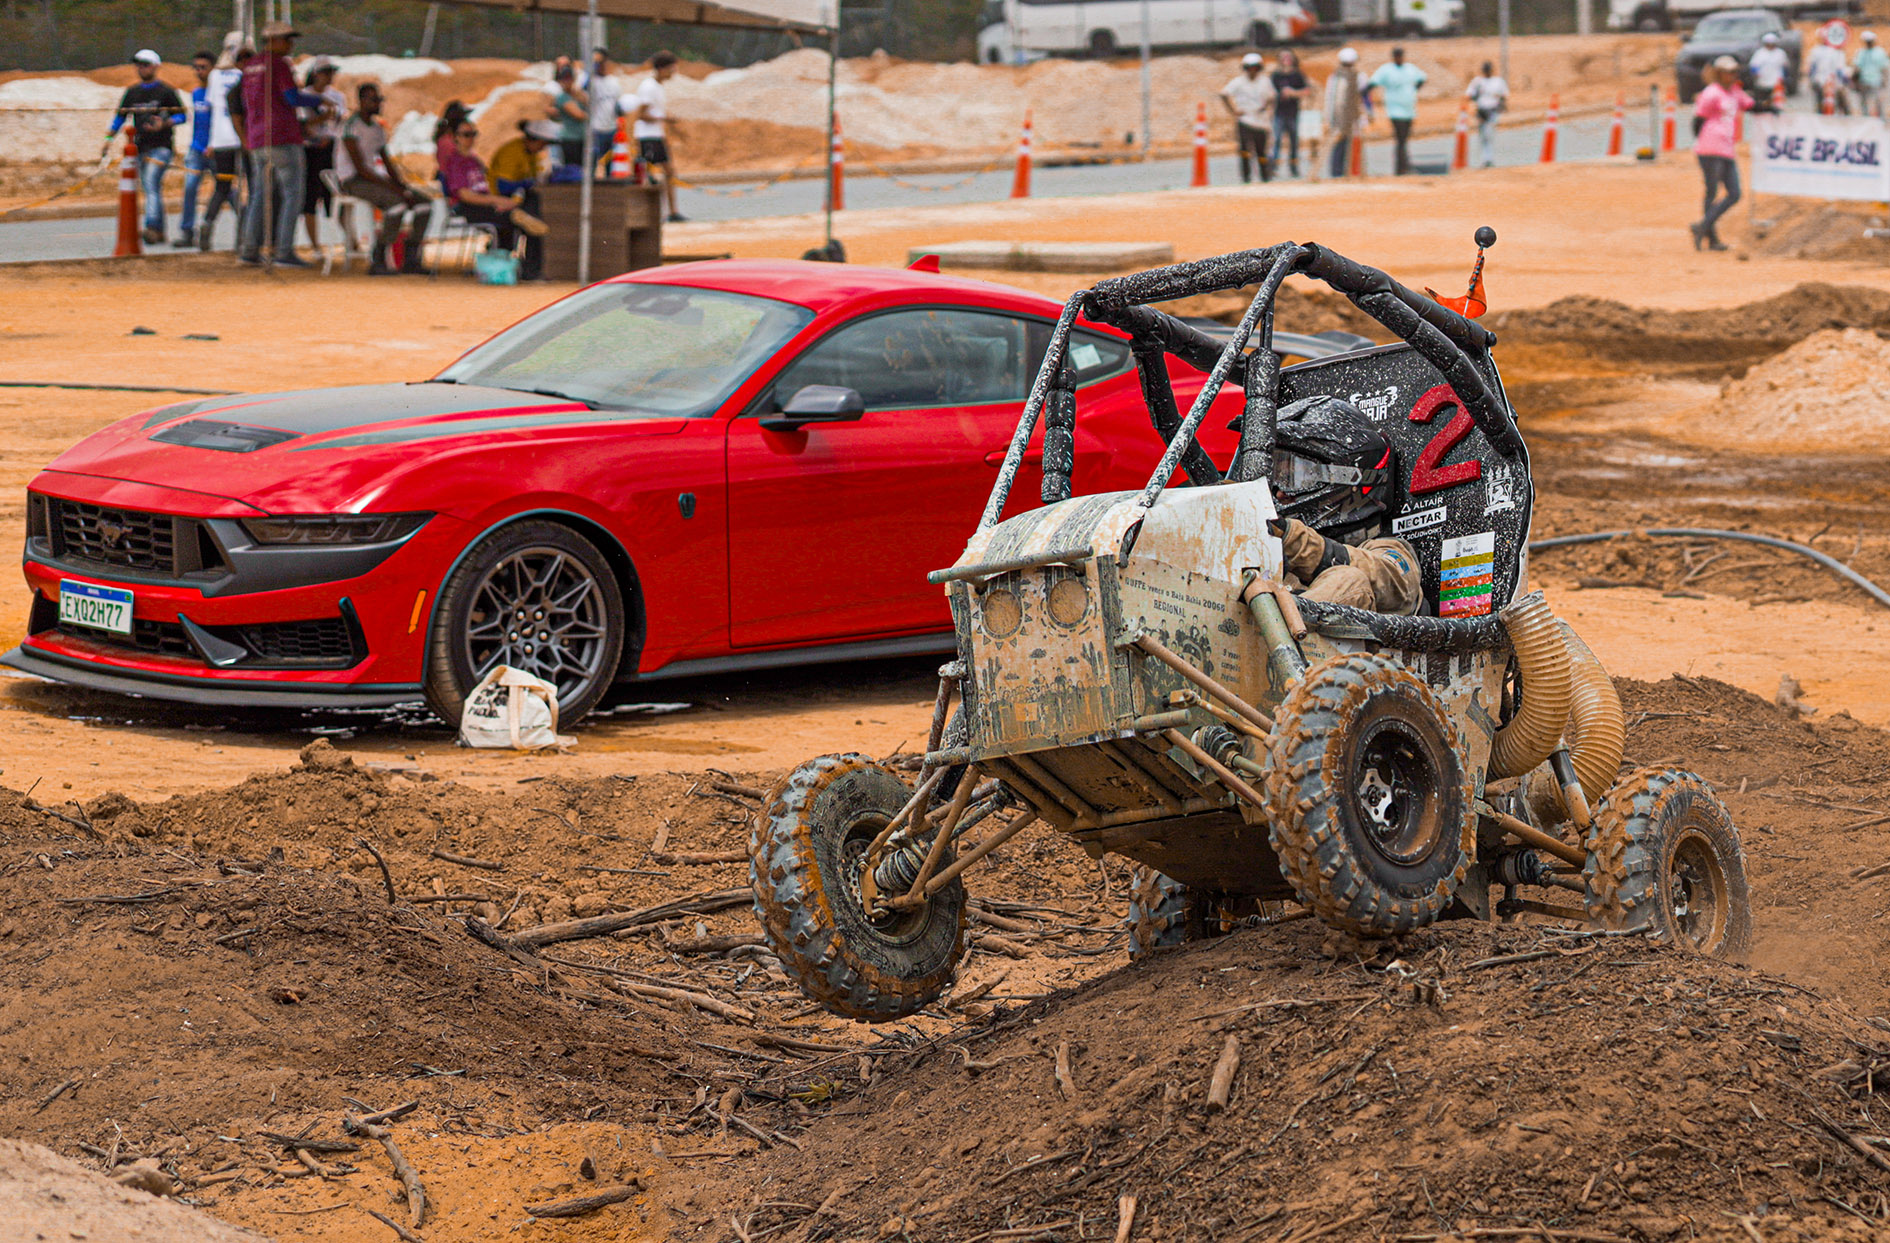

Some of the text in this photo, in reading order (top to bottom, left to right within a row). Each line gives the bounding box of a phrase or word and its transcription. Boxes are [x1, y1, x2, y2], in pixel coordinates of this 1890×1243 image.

[1767, 135, 1879, 165] SAE BRASIL
[1359, 394, 1389, 410] MANGUE
[1408, 382, 1481, 495] 2
[1413, 496, 1444, 510] ALTAIR
[1397, 511, 1441, 530] NECTAR
[65, 595, 123, 627] EXQ2H77
[1153, 599, 1186, 618] REGIONAL
